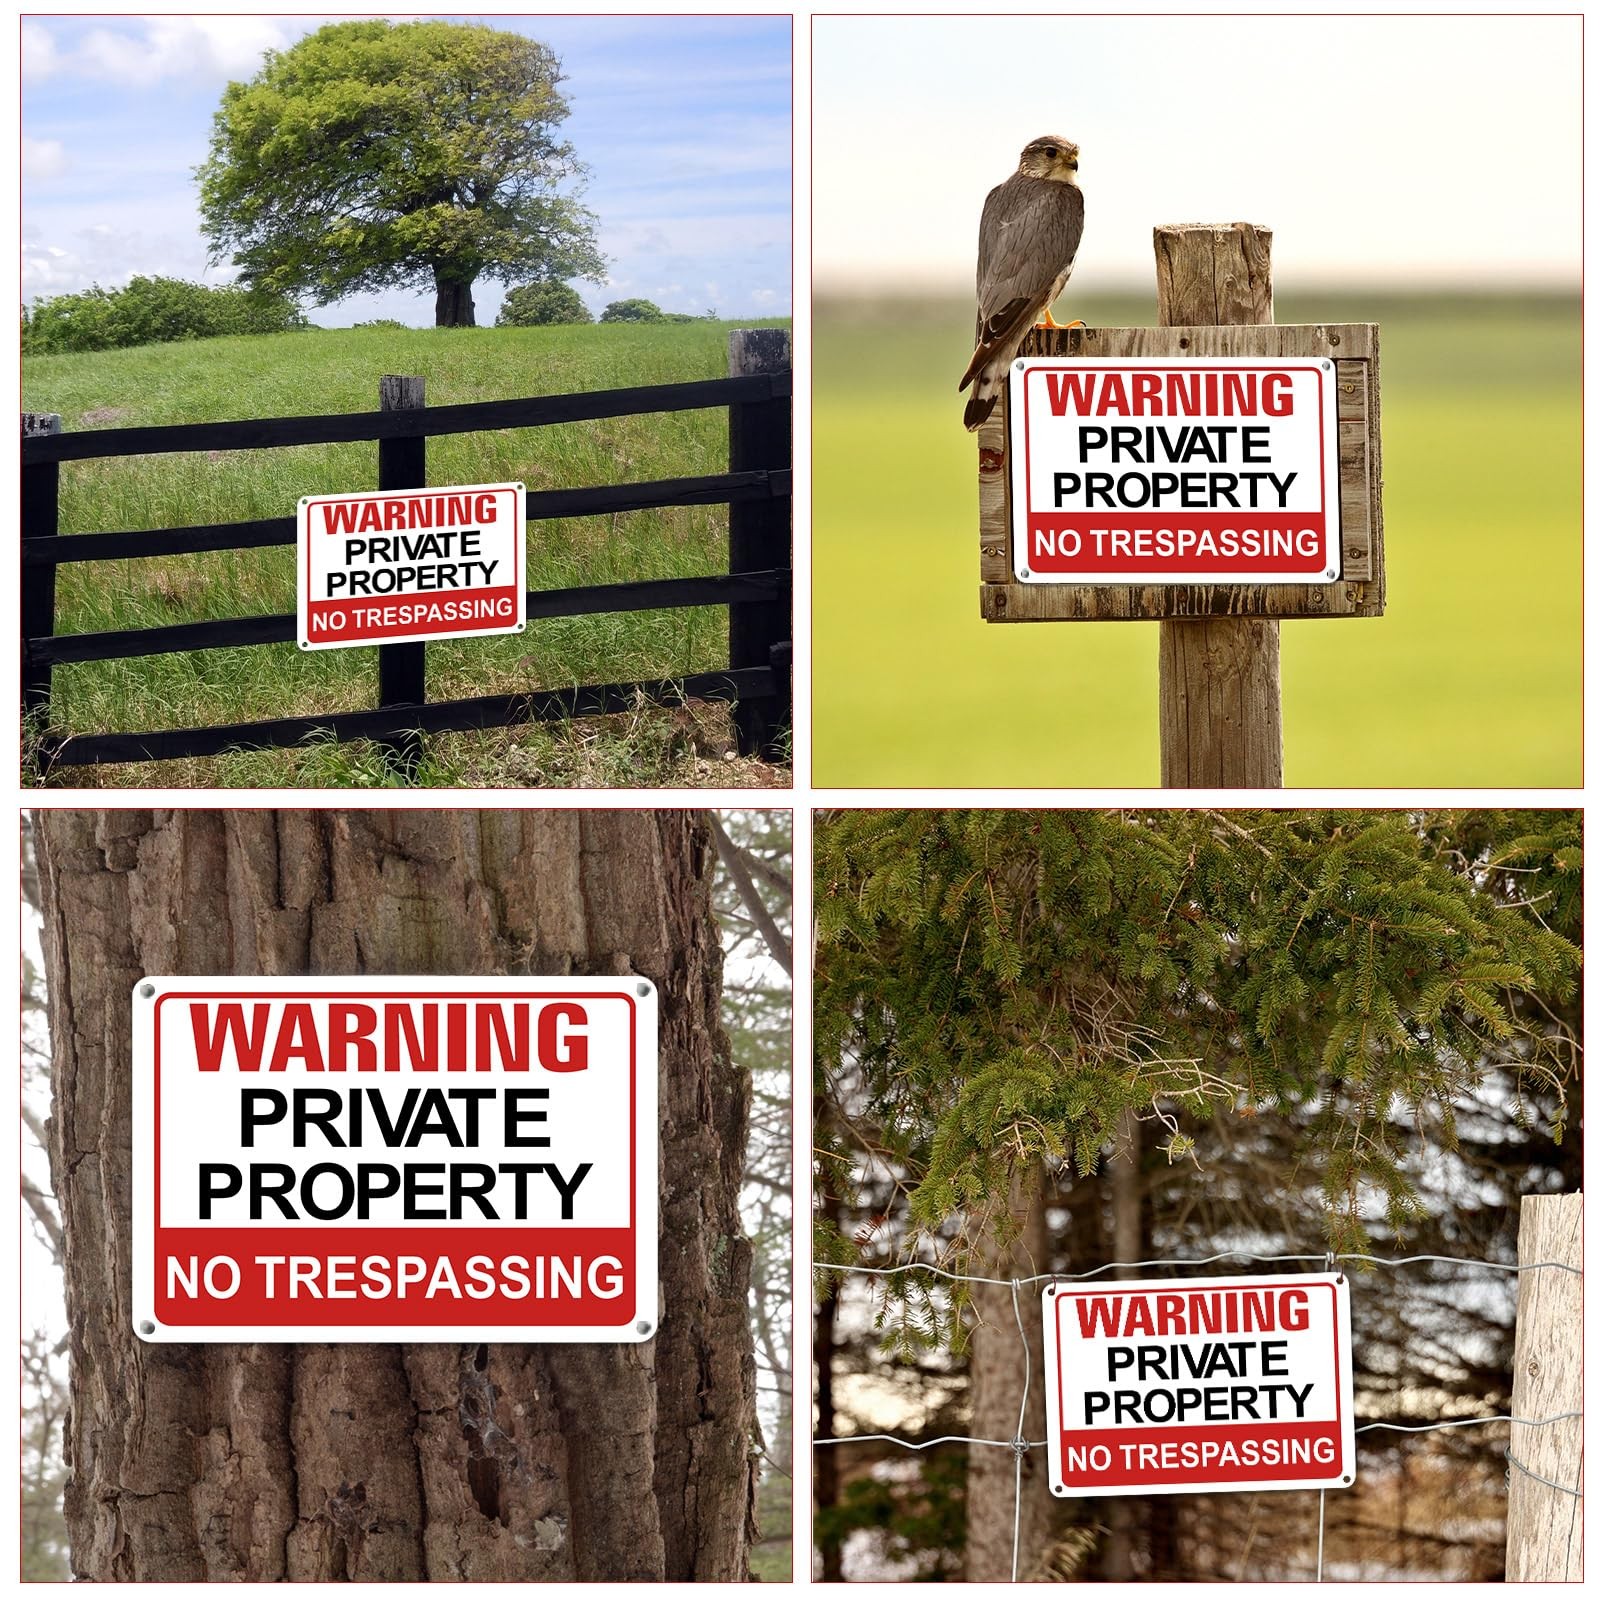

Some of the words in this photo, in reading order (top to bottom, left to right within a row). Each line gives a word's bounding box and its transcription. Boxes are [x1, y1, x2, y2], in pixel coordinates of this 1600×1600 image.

[1047, 373, 1294, 417] WARNING
[1079, 426, 1271, 463] PRIVATE
[1054, 472, 1298, 508] PROPERTY
[322, 494, 497, 536] WARNING
[345, 531, 481, 566] PRIVATE
[1035, 530, 1081, 558] NO
[1090, 529, 1319, 558] TRESPASSING
[327, 560, 499, 597] PROPERTY
[312, 609, 345, 632] NO
[352, 597, 513, 628] TRESPASSING
[189, 1002, 589, 1073] WARNING
[240, 1088, 550, 1148] PRIVATE
[199, 1162, 593, 1220] PROPERTY
[165, 1255, 241, 1300] NO
[256, 1255, 625, 1300] TRESPASSING
[1075, 1290, 1310, 1339] WARNING
[1107, 1341, 1288, 1383] PRIVATE
[1084, 1384, 1313, 1425] PROPERTY
[1068, 1445, 1112, 1472] NO
[1120, 1437, 1336, 1470] TRESPASSING
